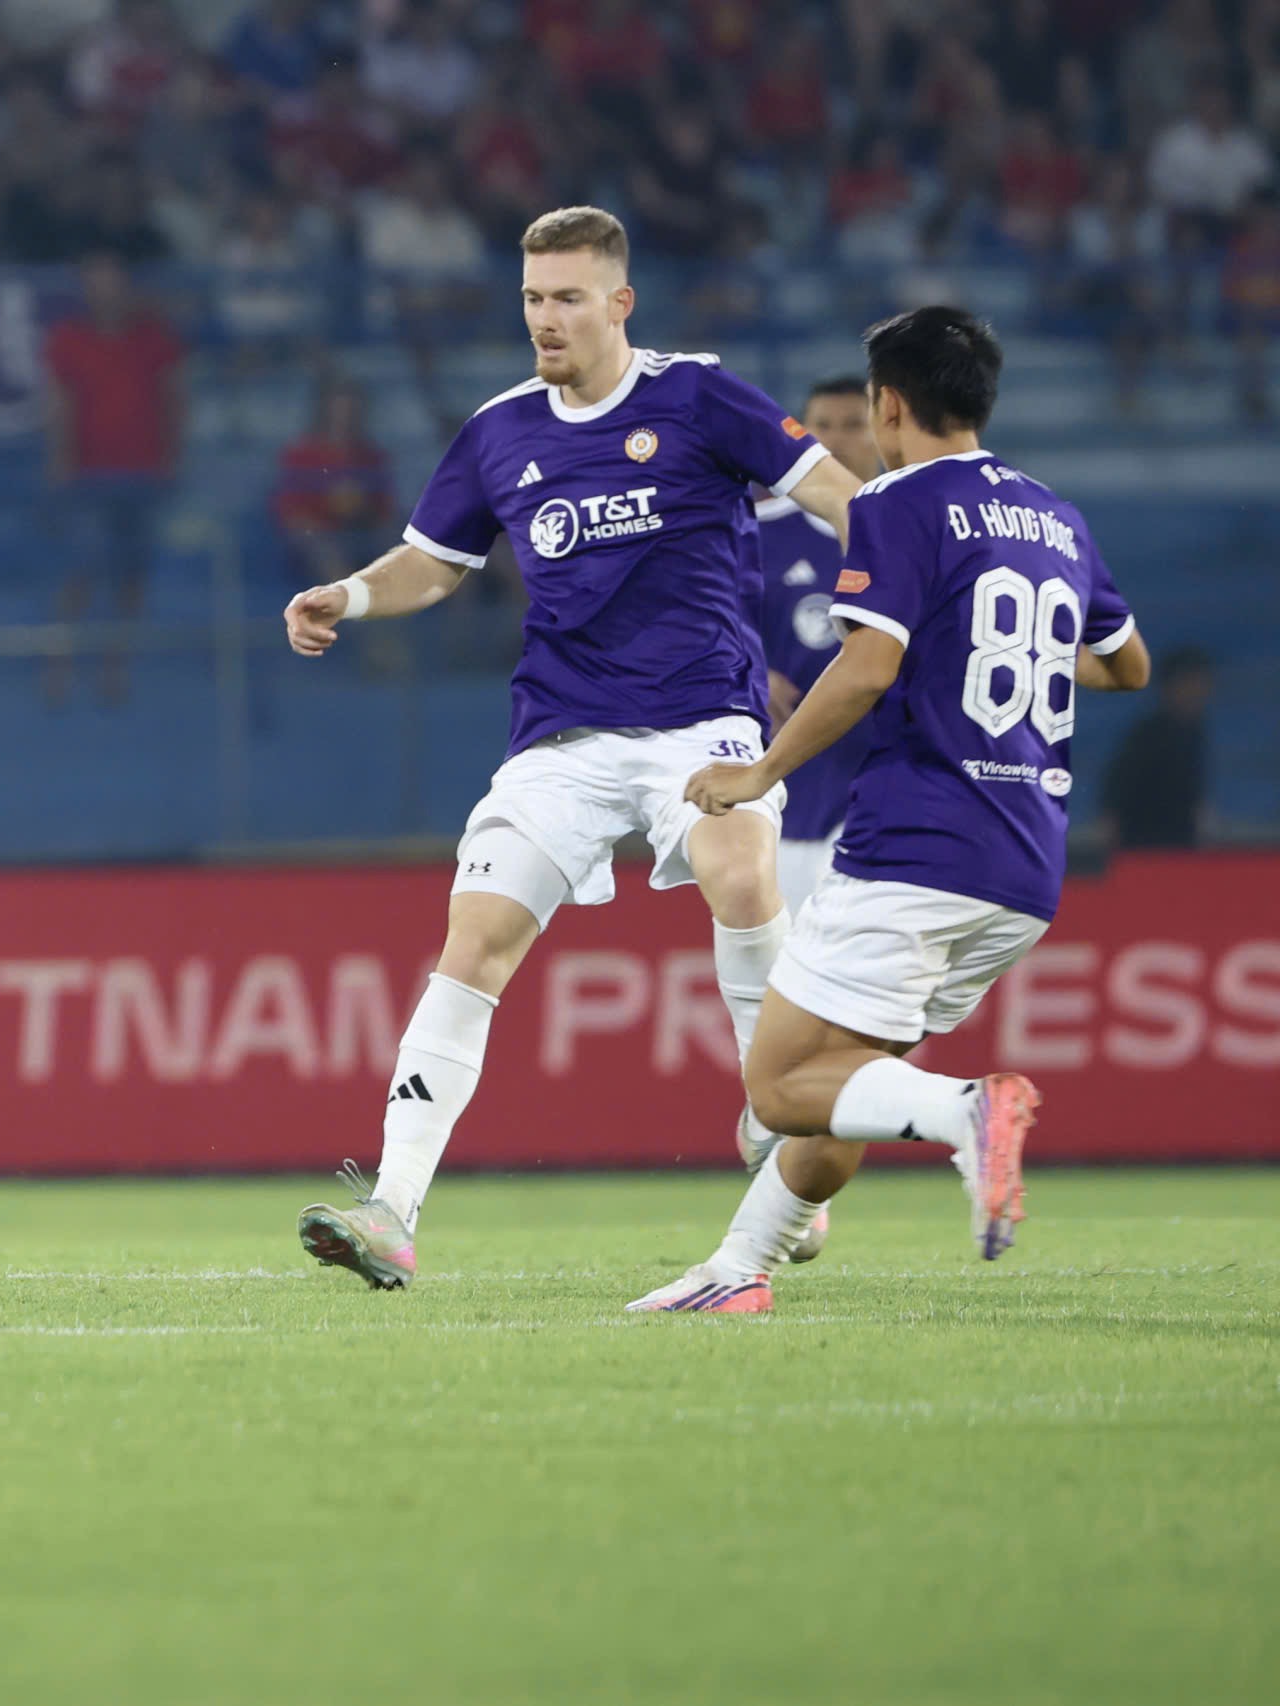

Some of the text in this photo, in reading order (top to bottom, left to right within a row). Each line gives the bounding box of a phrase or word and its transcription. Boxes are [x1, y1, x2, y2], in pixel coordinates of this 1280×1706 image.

[580, 486, 657, 525] T&T
[978, 498, 1040, 543] HÙNG
[582, 513, 664, 542] HOMES
[962, 565, 1082, 747] 88
